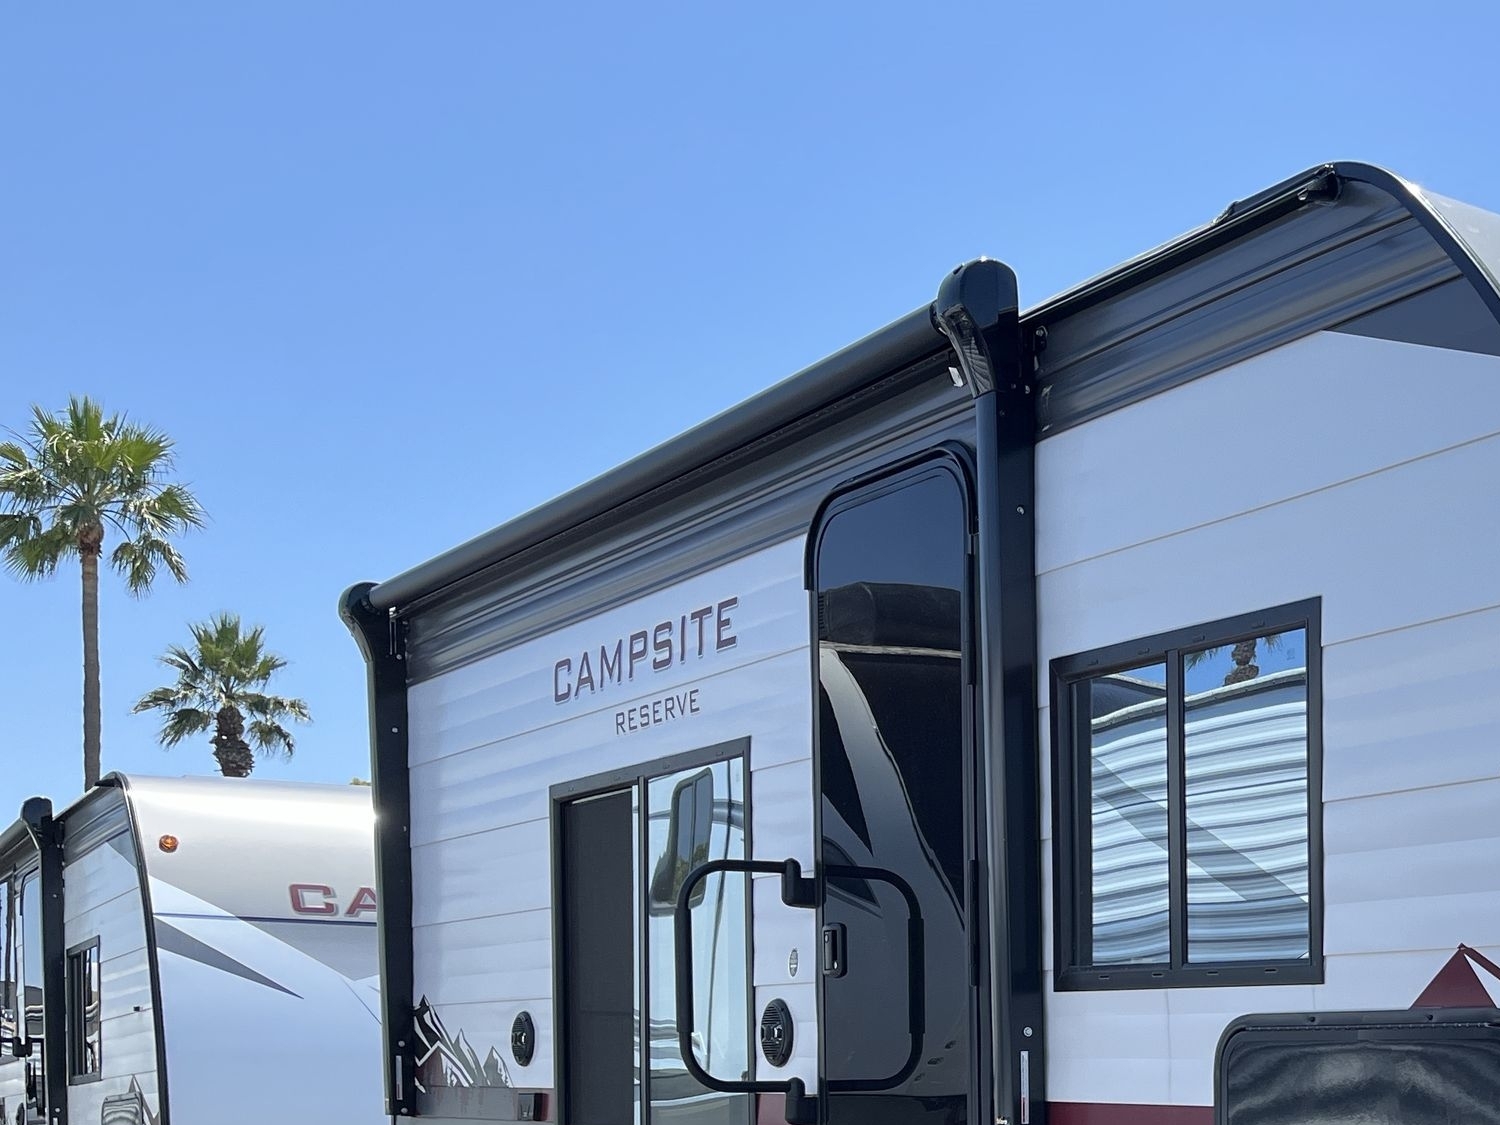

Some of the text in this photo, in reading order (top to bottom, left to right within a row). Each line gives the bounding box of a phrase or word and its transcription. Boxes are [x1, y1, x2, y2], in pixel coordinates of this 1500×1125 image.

[554, 596, 739, 704] CAMPSITE
[616, 688, 700, 735] RESERVE
[289, 884, 377, 917] CA
